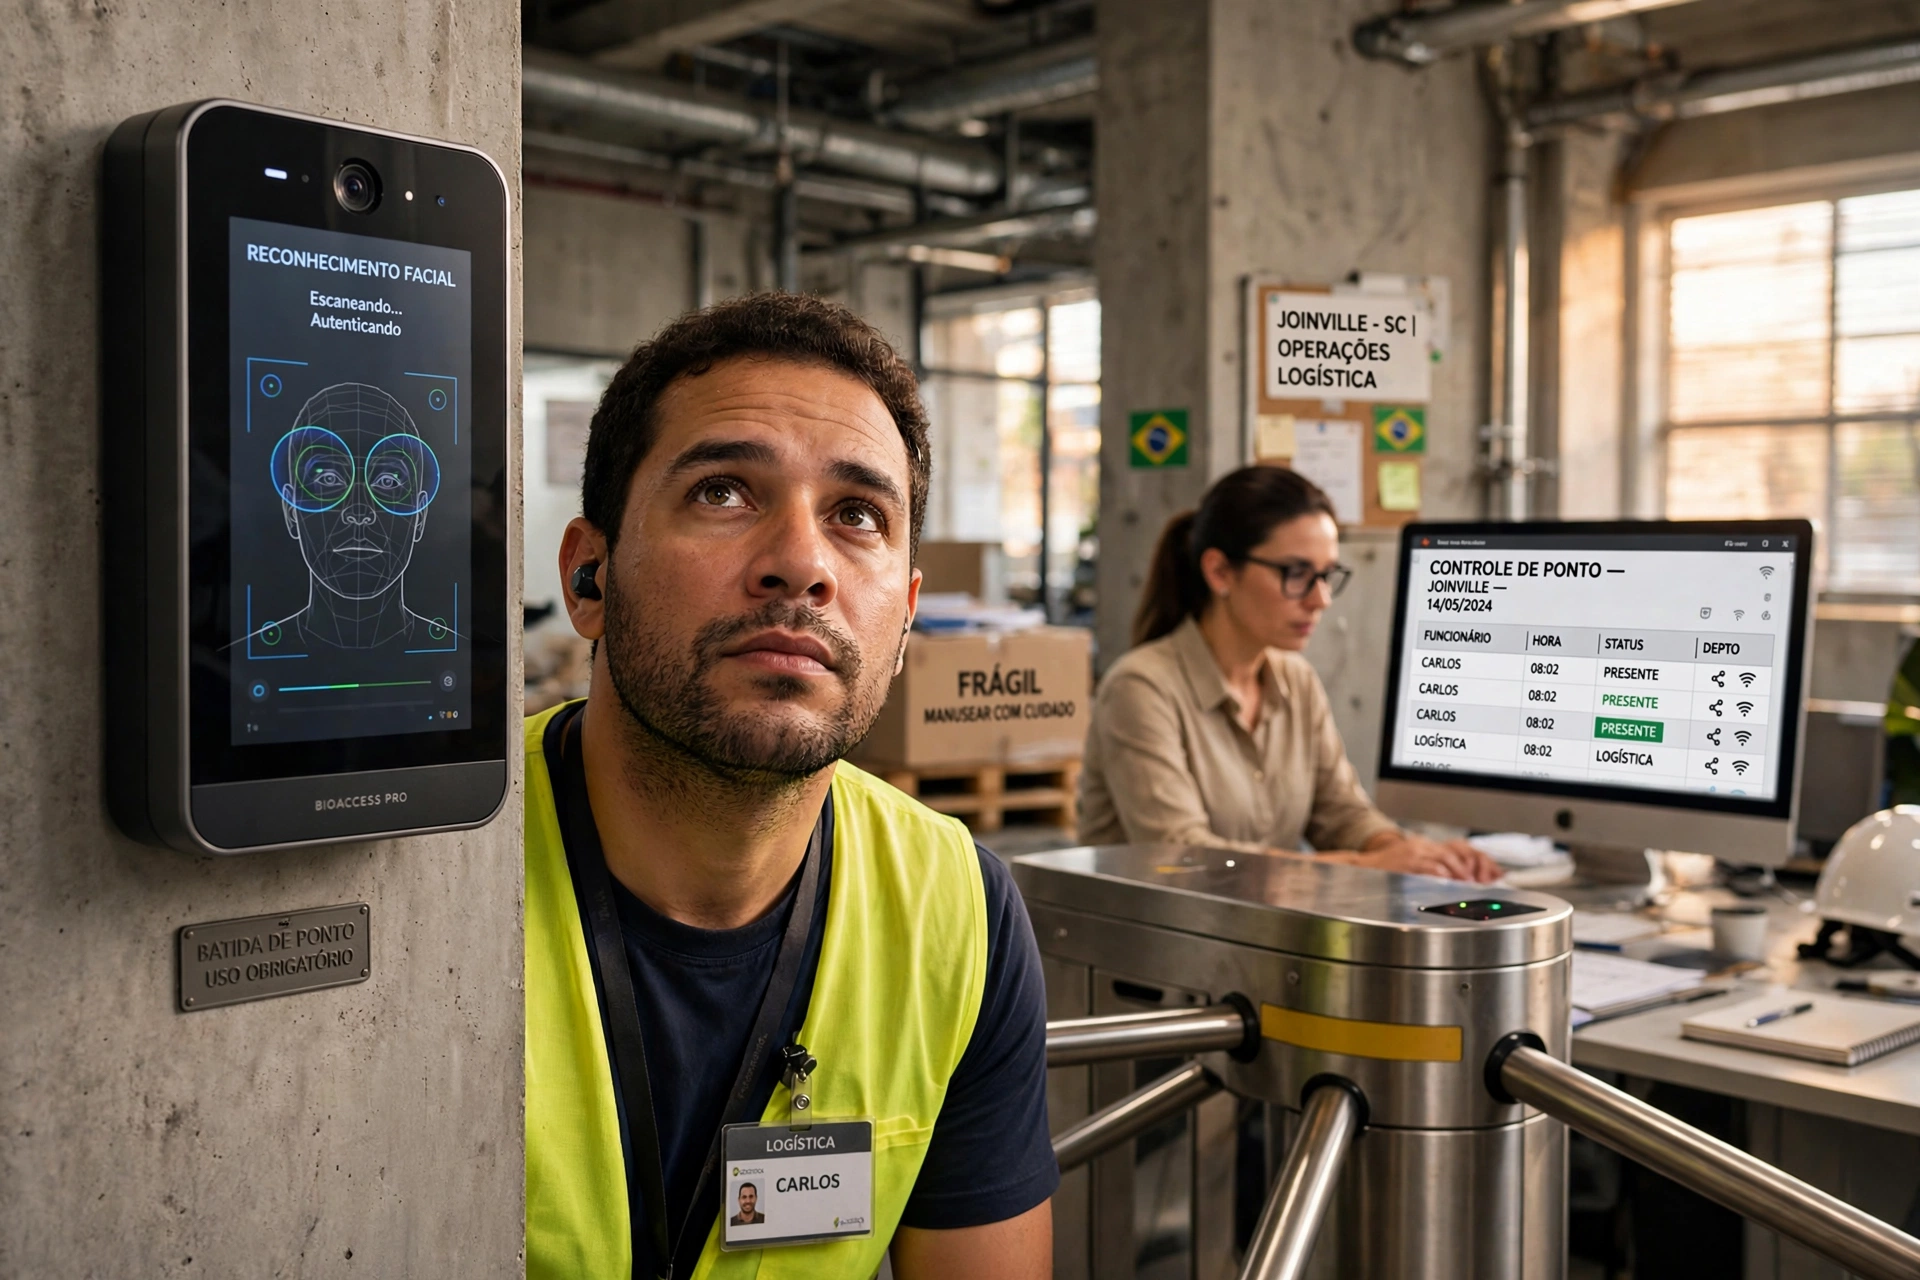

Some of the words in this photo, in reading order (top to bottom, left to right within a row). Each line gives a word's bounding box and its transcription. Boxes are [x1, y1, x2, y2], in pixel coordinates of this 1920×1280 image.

[246, 243, 400, 280] RECONHECIMENTO
[404, 266, 456, 287] FACIAL
[309, 290, 403, 316] Escaneando...
[309, 312, 402, 337] Autenticando
[1277, 310, 1369, 333] JOINVILLE
[1384, 315, 1407, 334] SC
[1277, 338, 1391, 365] OPERAÇÕES
[1277, 364, 1377, 389] LOGÍSTICA
[1430, 560, 1513, 577] CONTROLE
[1517, 561, 1539, 577] DE
[1543, 561, 1602, 579] PONTO
[1427, 580, 1490, 594] JOINVILLE
[1427, 598, 1493, 613] 14/05/2024
[1424, 629, 1492, 644] FUNCIONÁRIO
[1532, 635, 1562, 647] HORA
[1604, 638, 1644, 651] STATUS
[1702, 642, 1741, 655] DEPTO
[1421, 656, 1462, 670] CARLOS
[1530, 662, 1560, 675] 08:02
[957, 663, 1043, 698] FRÁGIL
[1603, 666, 1660, 681] PRESENTE
[1418, 682, 1459, 696] CARLOS
[1528, 689, 1557, 702] 08:02
[1602, 694, 1659, 710] PRESENTE
[924, 703, 991, 724] MANUSEAR
[993, 703, 1022, 721] COM
[1024, 701, 1076, 719] CUIDADO
[1416, 708, 1457, 722] CARLOS
[1525, 716, 1555, 730] 08:02
[1601, 722, 1657, 738] PRESENTE
[1414, 733, 1467, 750] LOGÍSTICA
[1523, 743, 1553, 757] 08:02
[1596, 748, 1654, 766] LOGÍSTICA
[314, 793, 381, 811] BIOACCESS
[385, 791, 408, 805] PRO
[197, 933, 264, 962] BATIDA
[268, 931, 293, 952] DE
[297, 921, 356, 948] PONTO
[205, 966, 241, 988] USO
[246, 948, 354, 982] OBRIGATÓRIO
[766, 1134, 836, 1153] LOGÍSTICA
[776, 1173, 840, 1193] CARLOS
